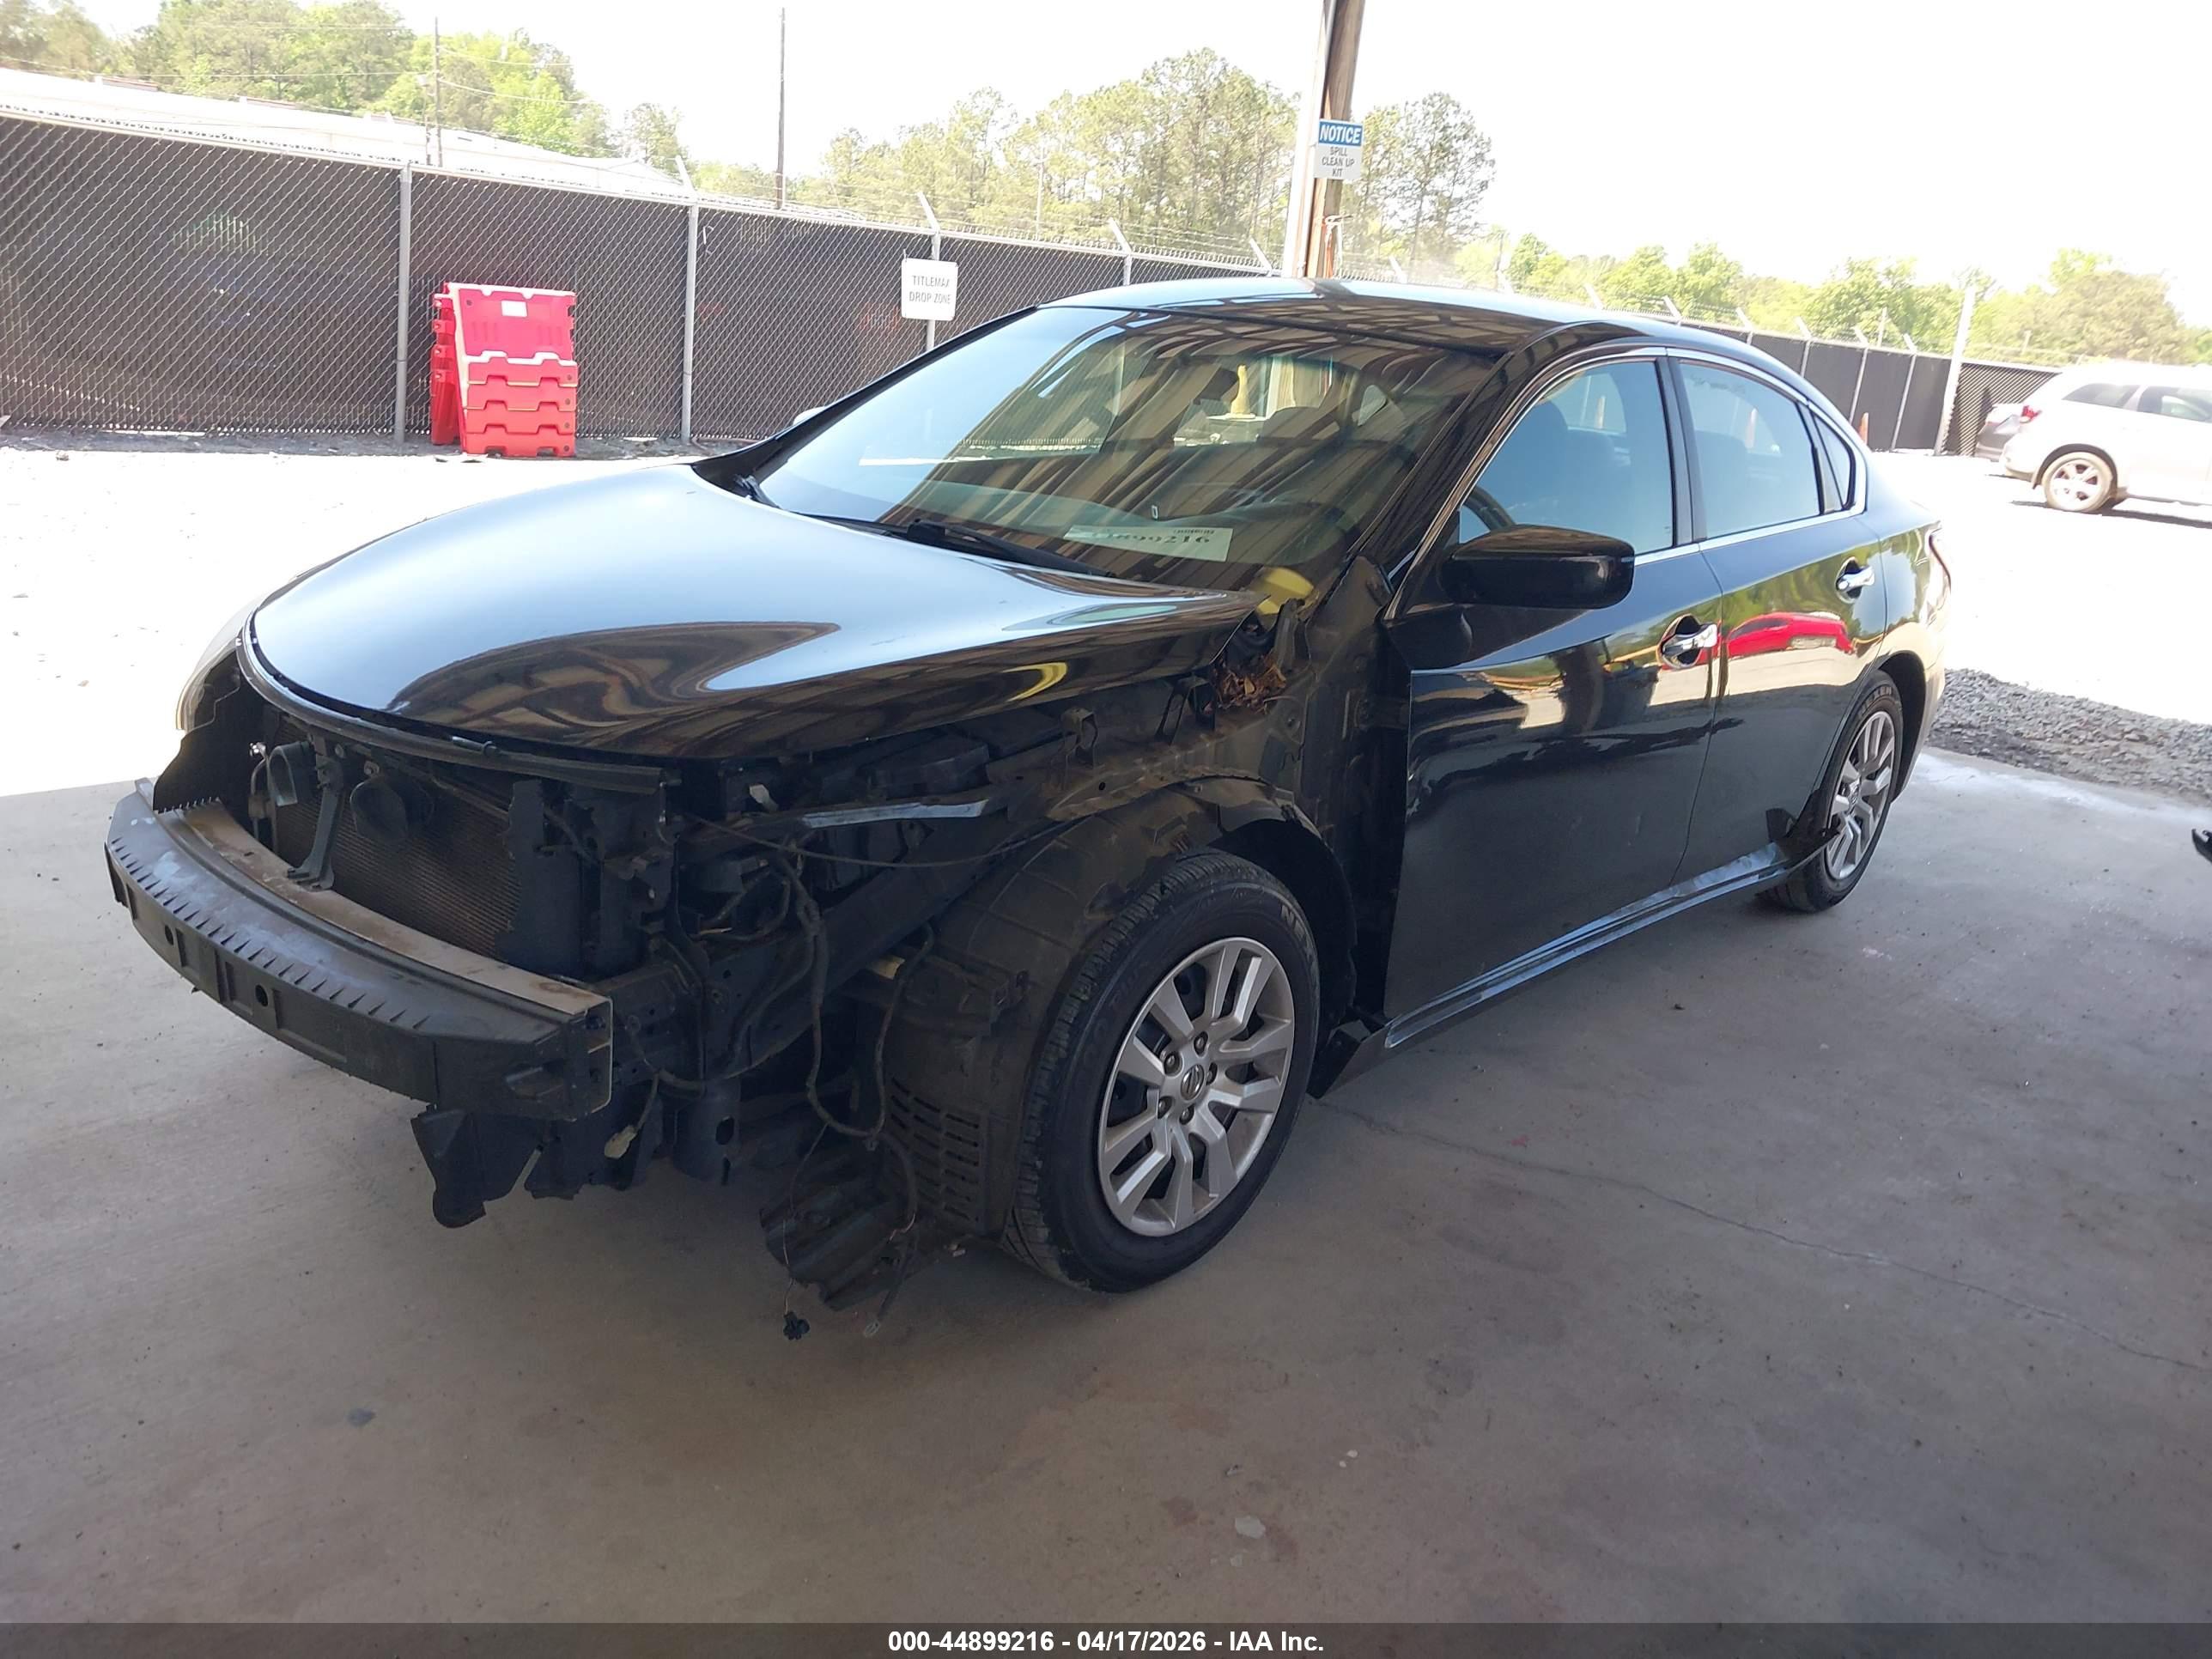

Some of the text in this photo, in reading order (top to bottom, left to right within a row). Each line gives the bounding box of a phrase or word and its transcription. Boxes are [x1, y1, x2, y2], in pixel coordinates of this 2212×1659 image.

[1320, 125, 1361, 144] NOTICE
[1330, 146, 1347, 155] SPILL
[1322, 156, 1355, 167] CLEAN UP
[1332, 168, 1342, 177] KIT
[908, 291, 951, 304] DROP ZONE
